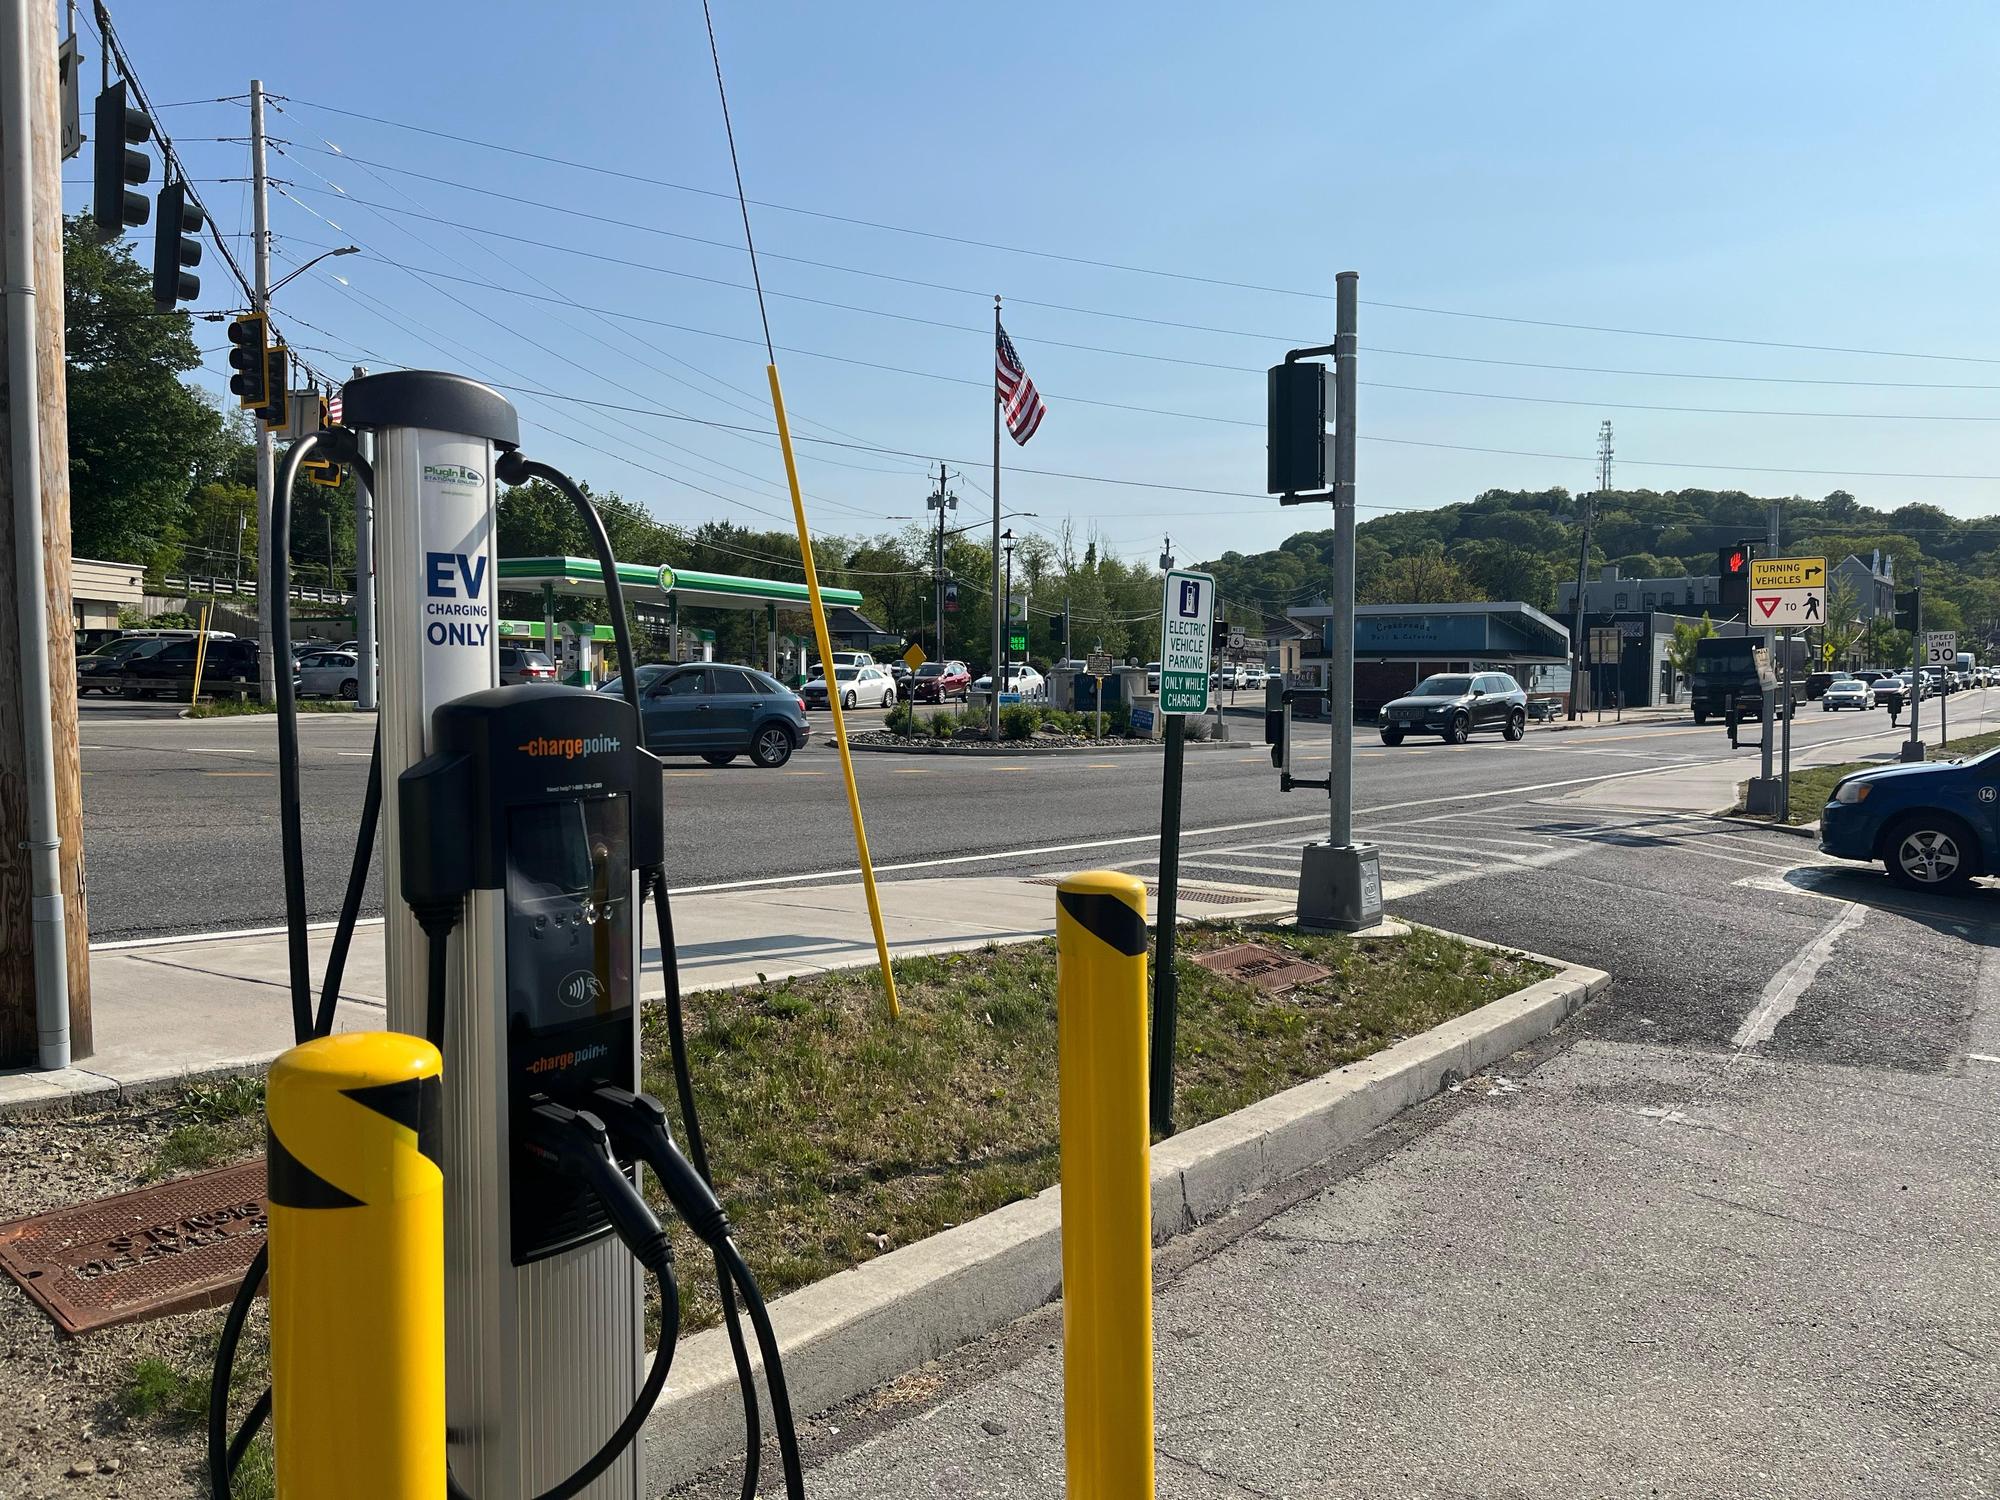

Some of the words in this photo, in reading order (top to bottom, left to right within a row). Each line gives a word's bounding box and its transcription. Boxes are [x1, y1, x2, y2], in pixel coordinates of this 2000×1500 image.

[1756, 563, 1800, 573] TURNING
[426, 551, 487, 600] EV
[1755, 575, 1801, 585] VEHICLES
[427, 603, 488, 617] CHARGING
[1784, 602, 1797, 611] TO
[427, 621, 489, 647] ONLY
[1169, 620, 1206, 637] ELECTRIC
[1234, 637, 1240, 645] 6
[1928, 633, 1955, 641] SPEED
[1170, 637, 1204, 653] VEHICLE
[1931, 640, 1951, 648] LIMIT
[1929, 648, 1954, 661] 30
[1168, 654, 1204, 670] PARKING
[1165, 676, 1183, 690] ONLY
[1185, 677, 1205, 691] WHILE
[1167, 693, 1201, 707] CHARGING
[1980, 789, 1994, 800] 14
